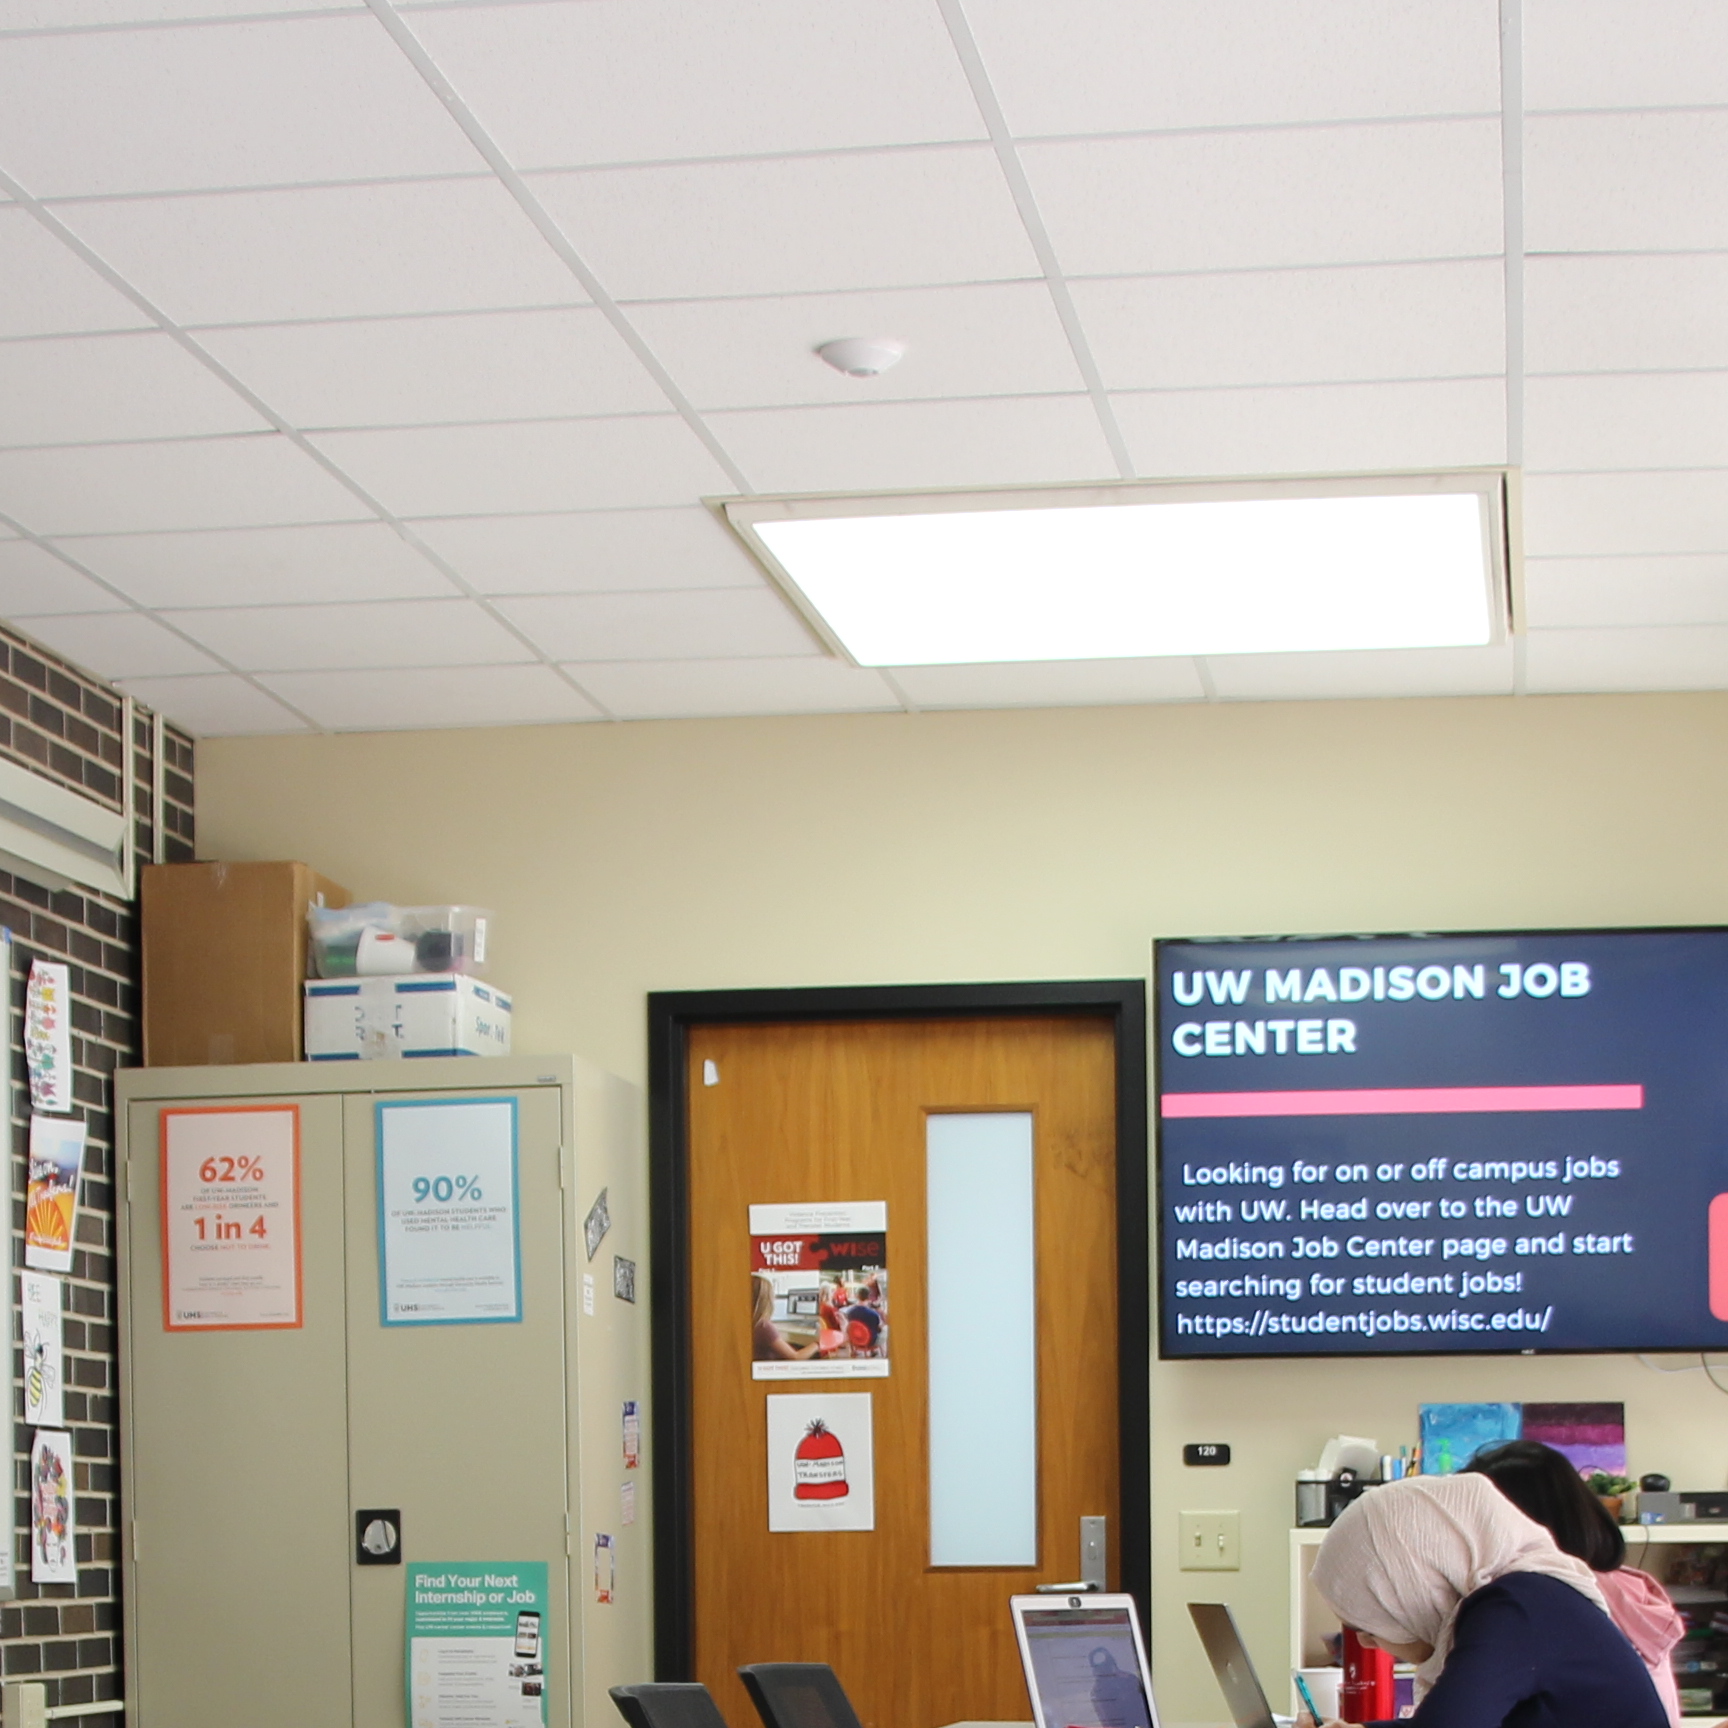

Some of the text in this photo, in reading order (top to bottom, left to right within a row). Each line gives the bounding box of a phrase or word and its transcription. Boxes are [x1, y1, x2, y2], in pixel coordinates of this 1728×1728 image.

[1172, 961, 1591, 1005] UW MADISON JOB
[1172, 1019, 1357, 1057] CENTER
[199, 1155, 264, 1183] 62%
[1182, 1156, 1620, 1189] Looking for on or off campus jobs
[412, 1175, 482, 1203] 90%
[421, 1216, 448, 1224] MENTAL
[450, 1215, 477, 1223] HEALTH
[451, 1207, 487, 1215] STUDENTS
[1174, 1195, 1573, 1223] with UW. Head over to the UW
[193, 1214, 267, 1240] 1 in 4
[760, 1242, 772, 1254] U
[773, 1241, 803, 1254] GOT
[764, 1253, 799, 1266] THIS!
[1176, 1231, 1633, 1261] Madison Job Center page and start
[1175, 1271, 1522, 1300] searching for student jobs!
[1176, 1305, 1553, 1338] https://studentjobs.wisc.edu/
[1198, 1446, 1217, 1456] 120
[415, 1574, 518, 1588] Find Your Next
[415, 1590, 536, 1606] Internship or Job
